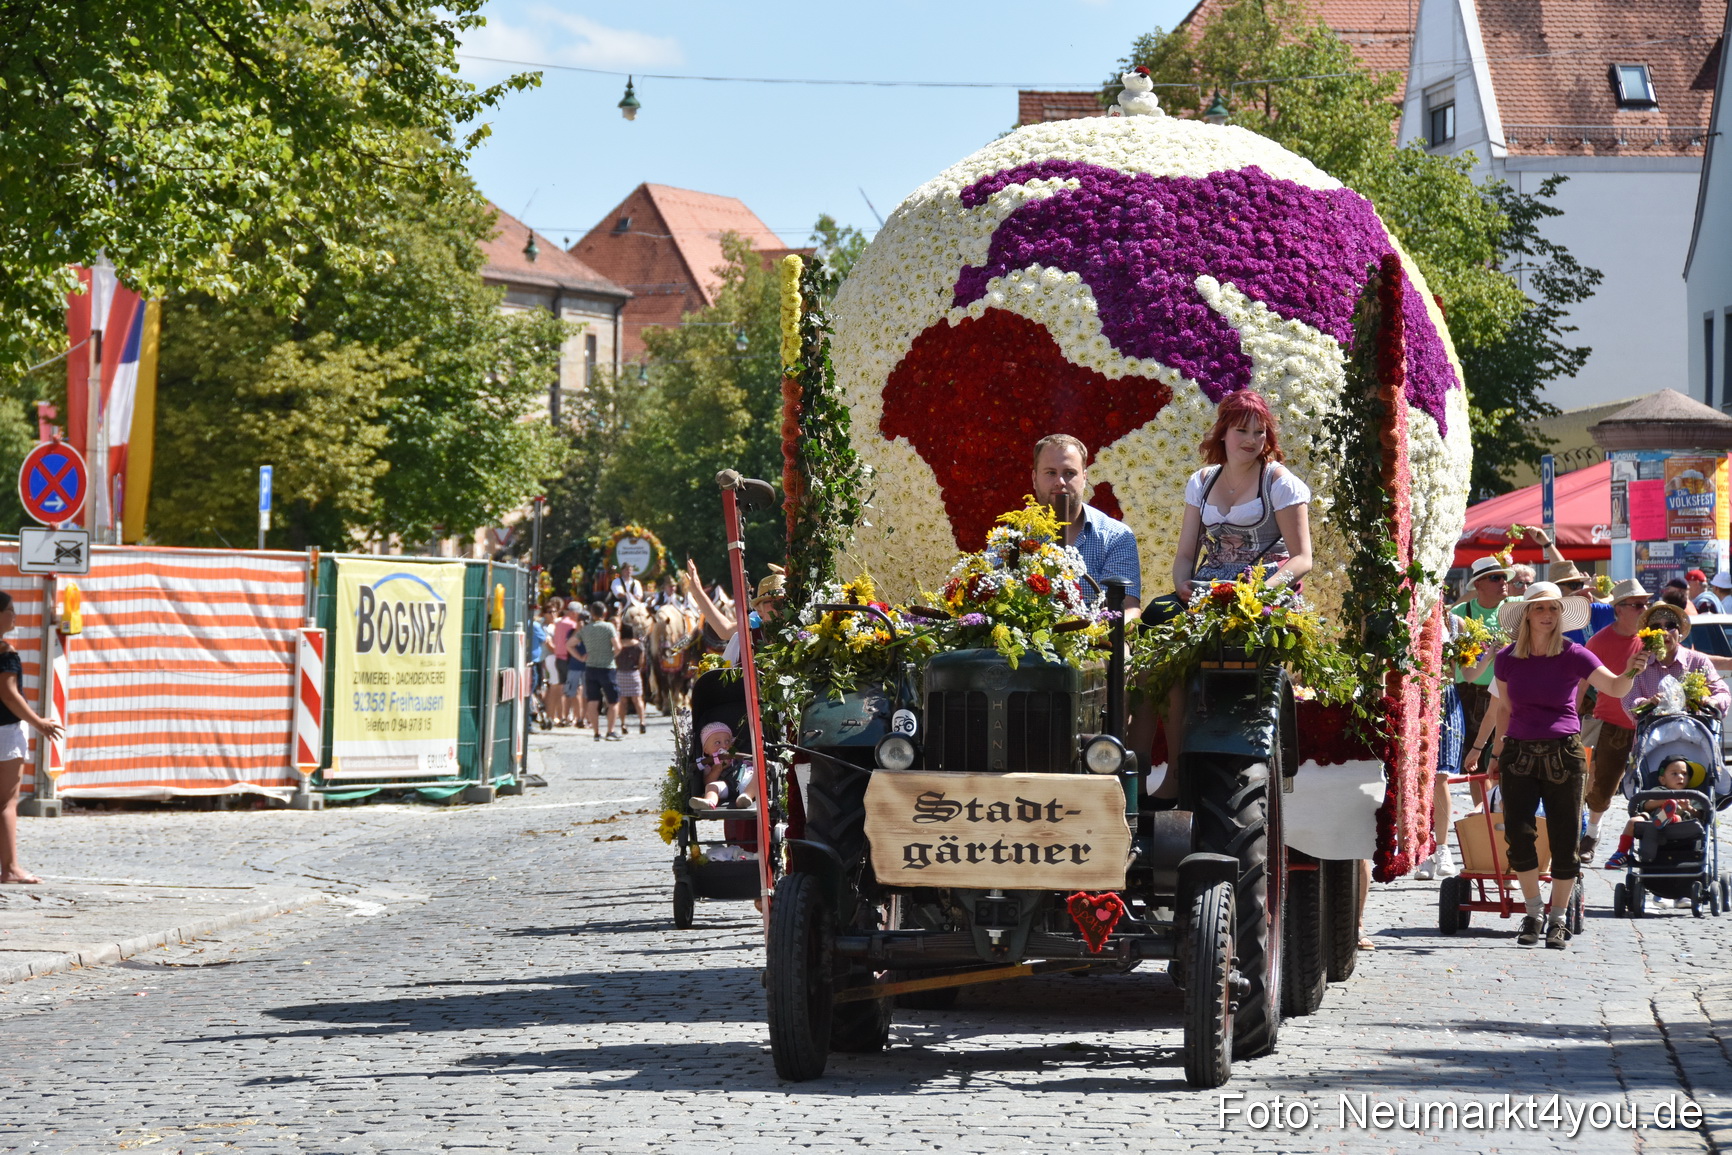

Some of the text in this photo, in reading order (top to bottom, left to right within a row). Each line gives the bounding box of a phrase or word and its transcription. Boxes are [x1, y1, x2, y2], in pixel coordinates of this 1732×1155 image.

[1669, 493, 1713, 508] VOLKSFEST
[356, 586, 446, 654] BOGNER
[396, 671, 446, 685] DACHDECKEREI
[353, 691, 444, 712] 92358 Freihausen
[365, 718, 390, 731] Telefon
[912, 790, 1082, 824] Stadt-
[901, 835, 1092, 870] gärtner
